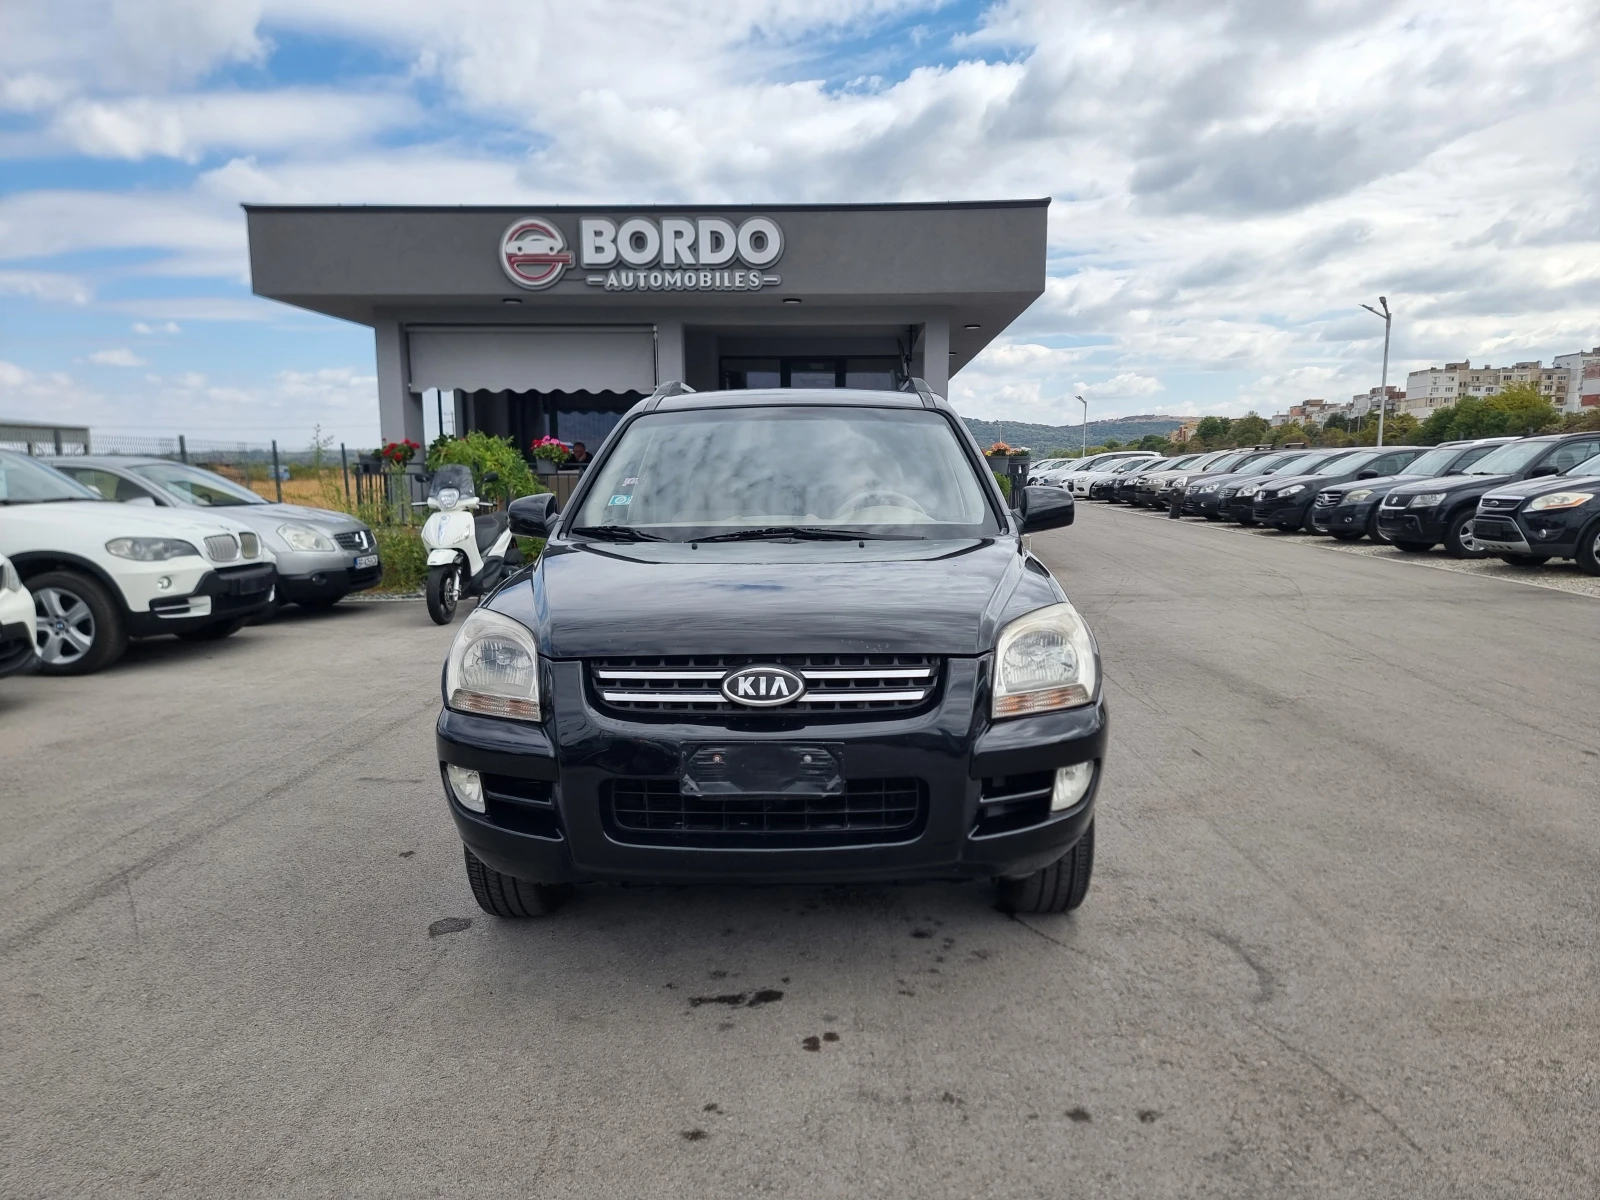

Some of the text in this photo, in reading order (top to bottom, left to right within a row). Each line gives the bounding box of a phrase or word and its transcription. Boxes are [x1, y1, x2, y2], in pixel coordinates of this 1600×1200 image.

[581, 218, 781, 265] BORDO
[606, 271, 760, 288] AUTOMOBILES
[737, 676, 790, 696] KIA
